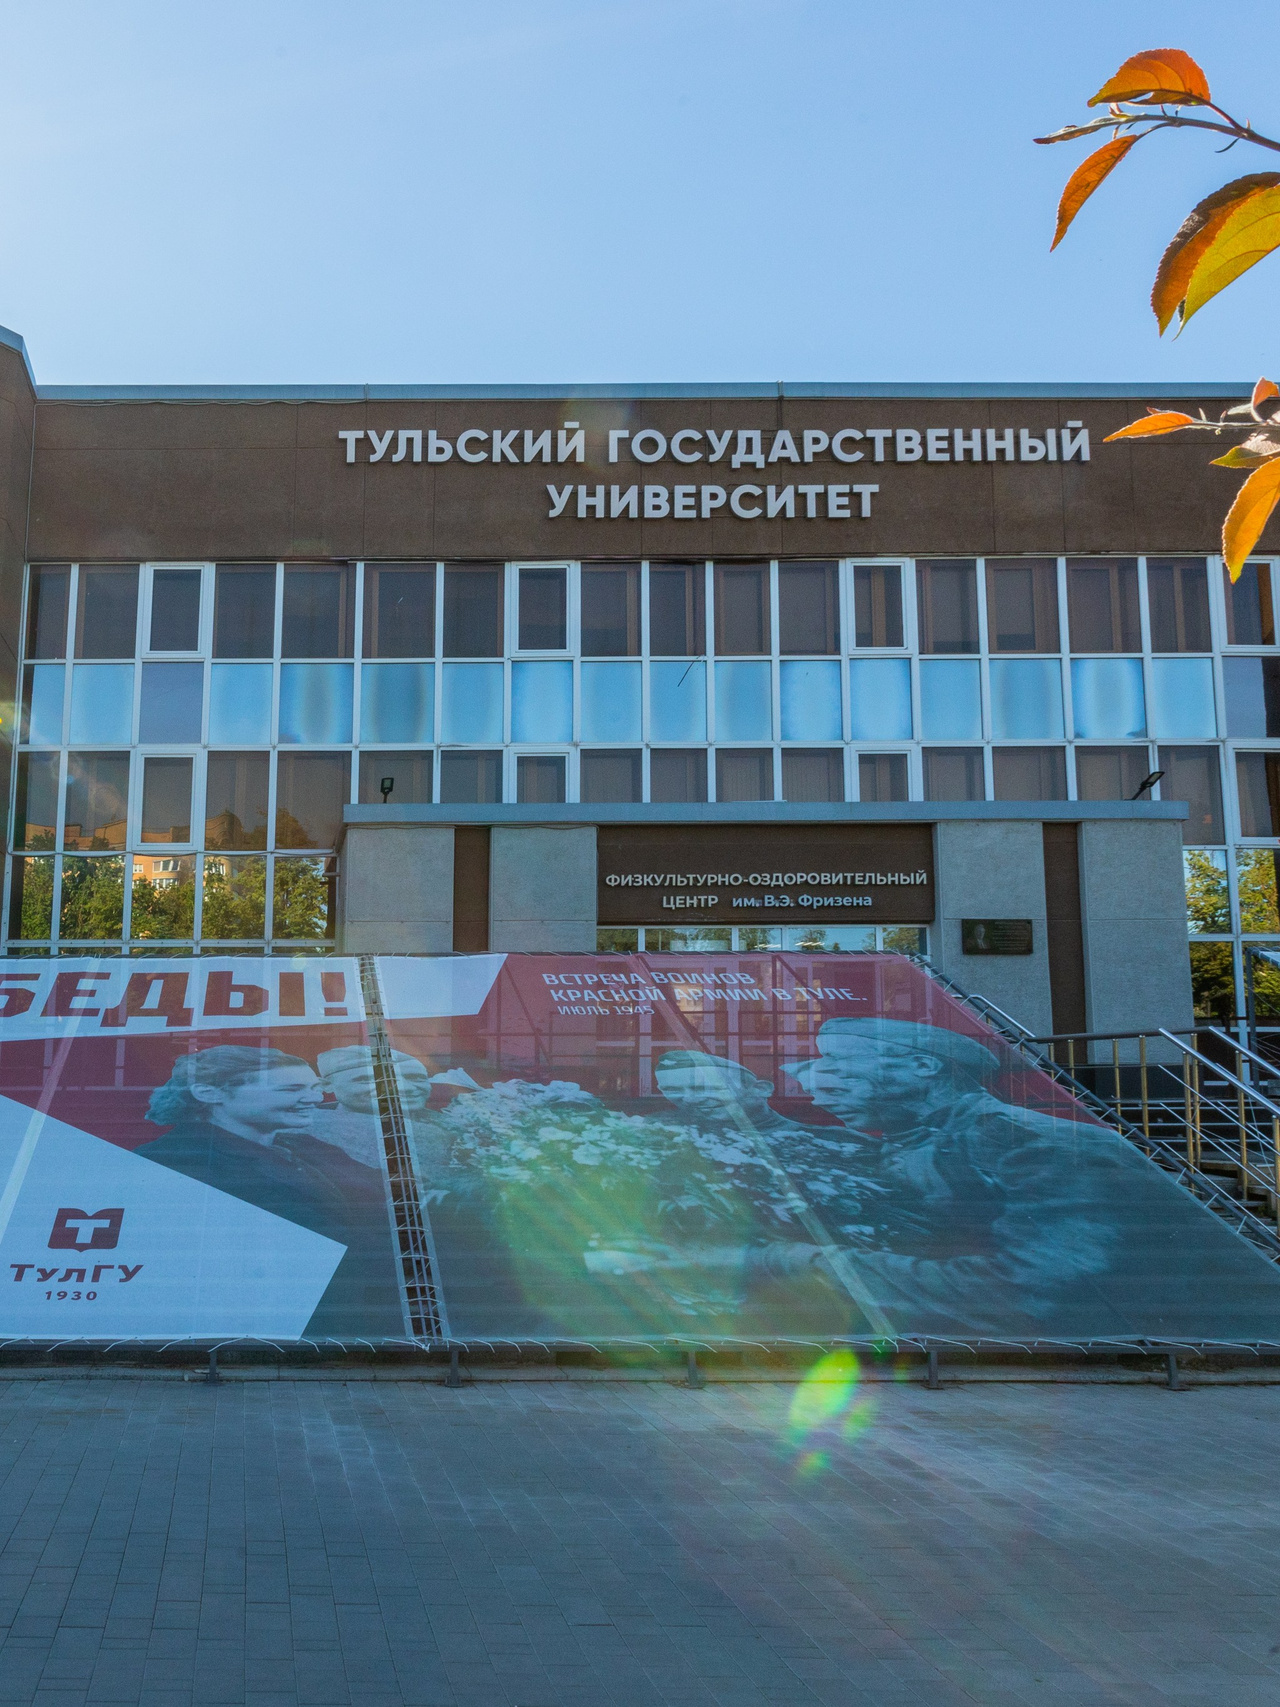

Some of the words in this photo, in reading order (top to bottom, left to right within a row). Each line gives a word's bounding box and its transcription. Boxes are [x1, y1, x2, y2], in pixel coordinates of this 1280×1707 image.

[338, 421, 586, 463] ТУЛЬСКИЙ
[609, 420, 1091, 469] ГОСУДАРСТВЕННЫЙ
[546, 484, 880, 519] УНИВЕРСИТЕТ
[605, 869, 928, 888] ФИЗКУЛЬТУРНО-ОЗДОРОВИТЕЛЬНЫЙ
[662, 895, 719, 910] ЦЕНТР
[732, 897, 760, 907] им.
[798, 894, 872, 909] Фризена
[542, 973, 647, 985] ВСТРЕЧА
[650, 972, 756, 985] ВОИНОВ
[550, 986, 667, 1001] КРАСНОЙ
[674, 988, 769, 1001] АРМИИ
[772, 988, 792, 1001] В
[795, 987, 867, 1000] ТУЛЕ.
[557, 1005, 611, 1015] ИЮЛЬ
[616, 1005, 655, 1015] 1945
[10, 1263, 144, 1283] ТулГУ
[45, 1290, 97, 1301] 1930
